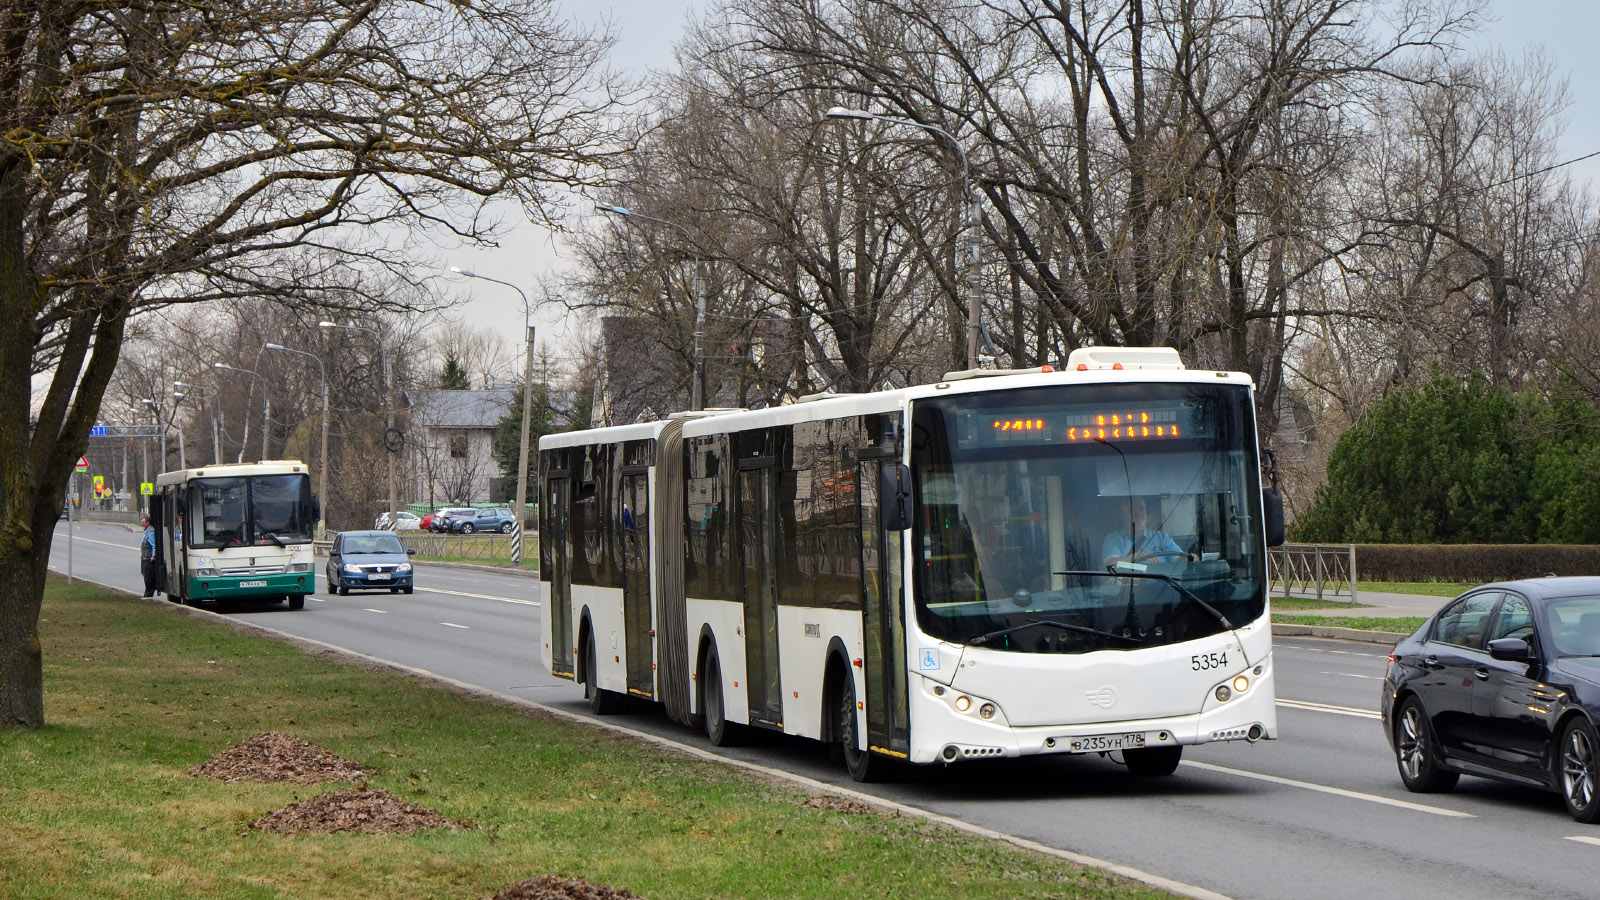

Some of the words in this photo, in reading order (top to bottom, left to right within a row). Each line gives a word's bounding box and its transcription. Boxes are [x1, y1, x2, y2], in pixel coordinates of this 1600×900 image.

[1043, 626, 1164, 643] VOLBUS
[1191, 651, 1228, 671] 5354
[1074, 736, 1122, 751] В235УН
[1124, 733, 1142, 744] 178
